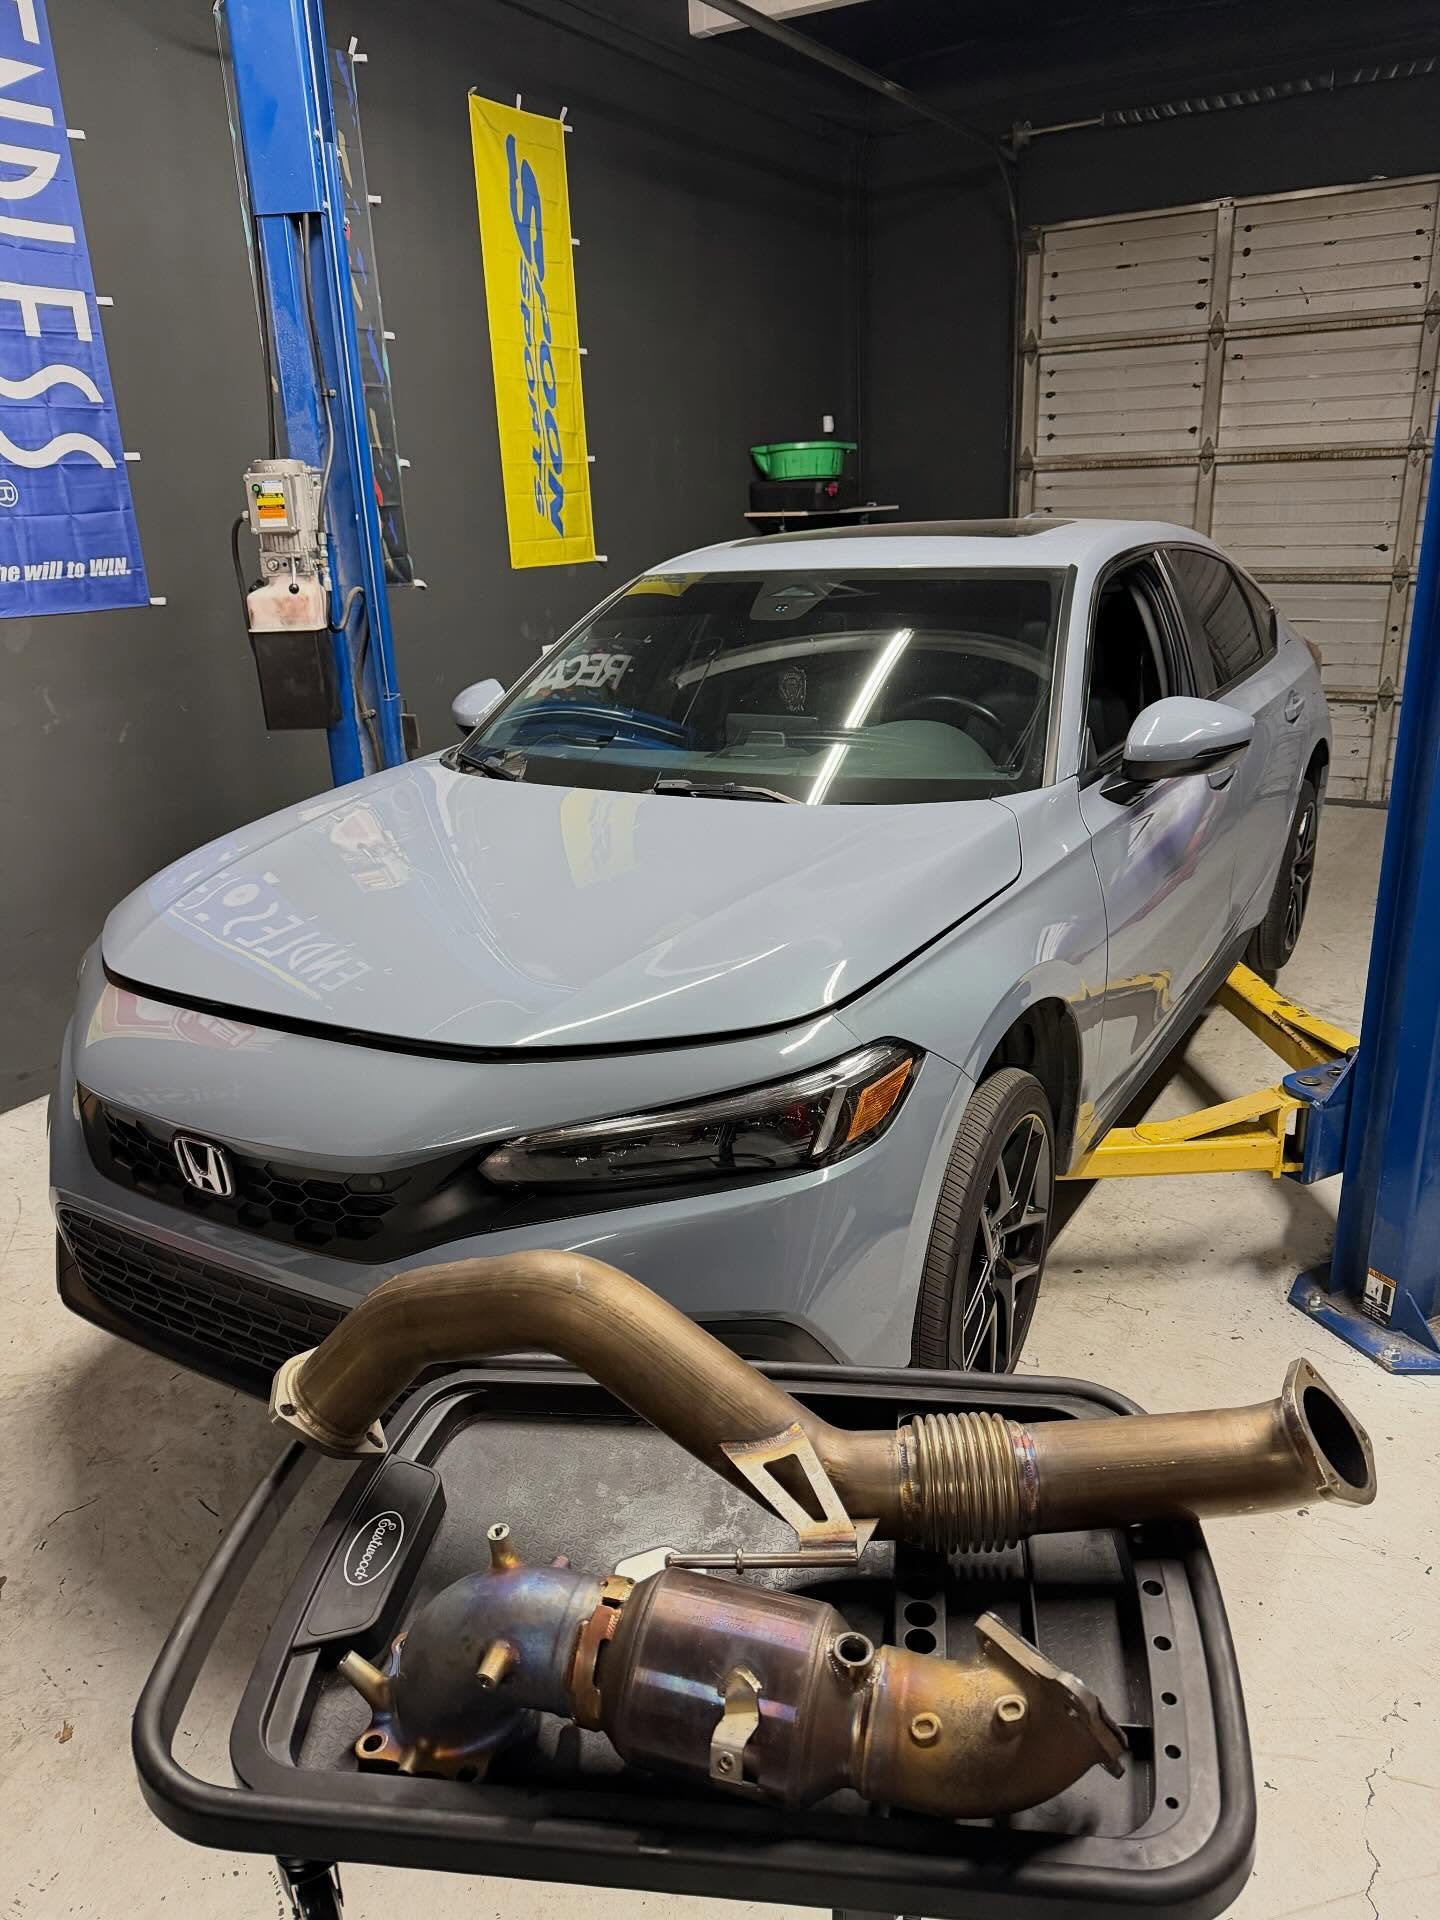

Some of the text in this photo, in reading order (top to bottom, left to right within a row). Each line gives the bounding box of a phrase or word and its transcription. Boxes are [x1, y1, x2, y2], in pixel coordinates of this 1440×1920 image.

[520, 256, 545, 517] SPORTS
[0, 557, 131, 582] he will to WIN.
[355, 1519, 396, 1579] Eastwood
